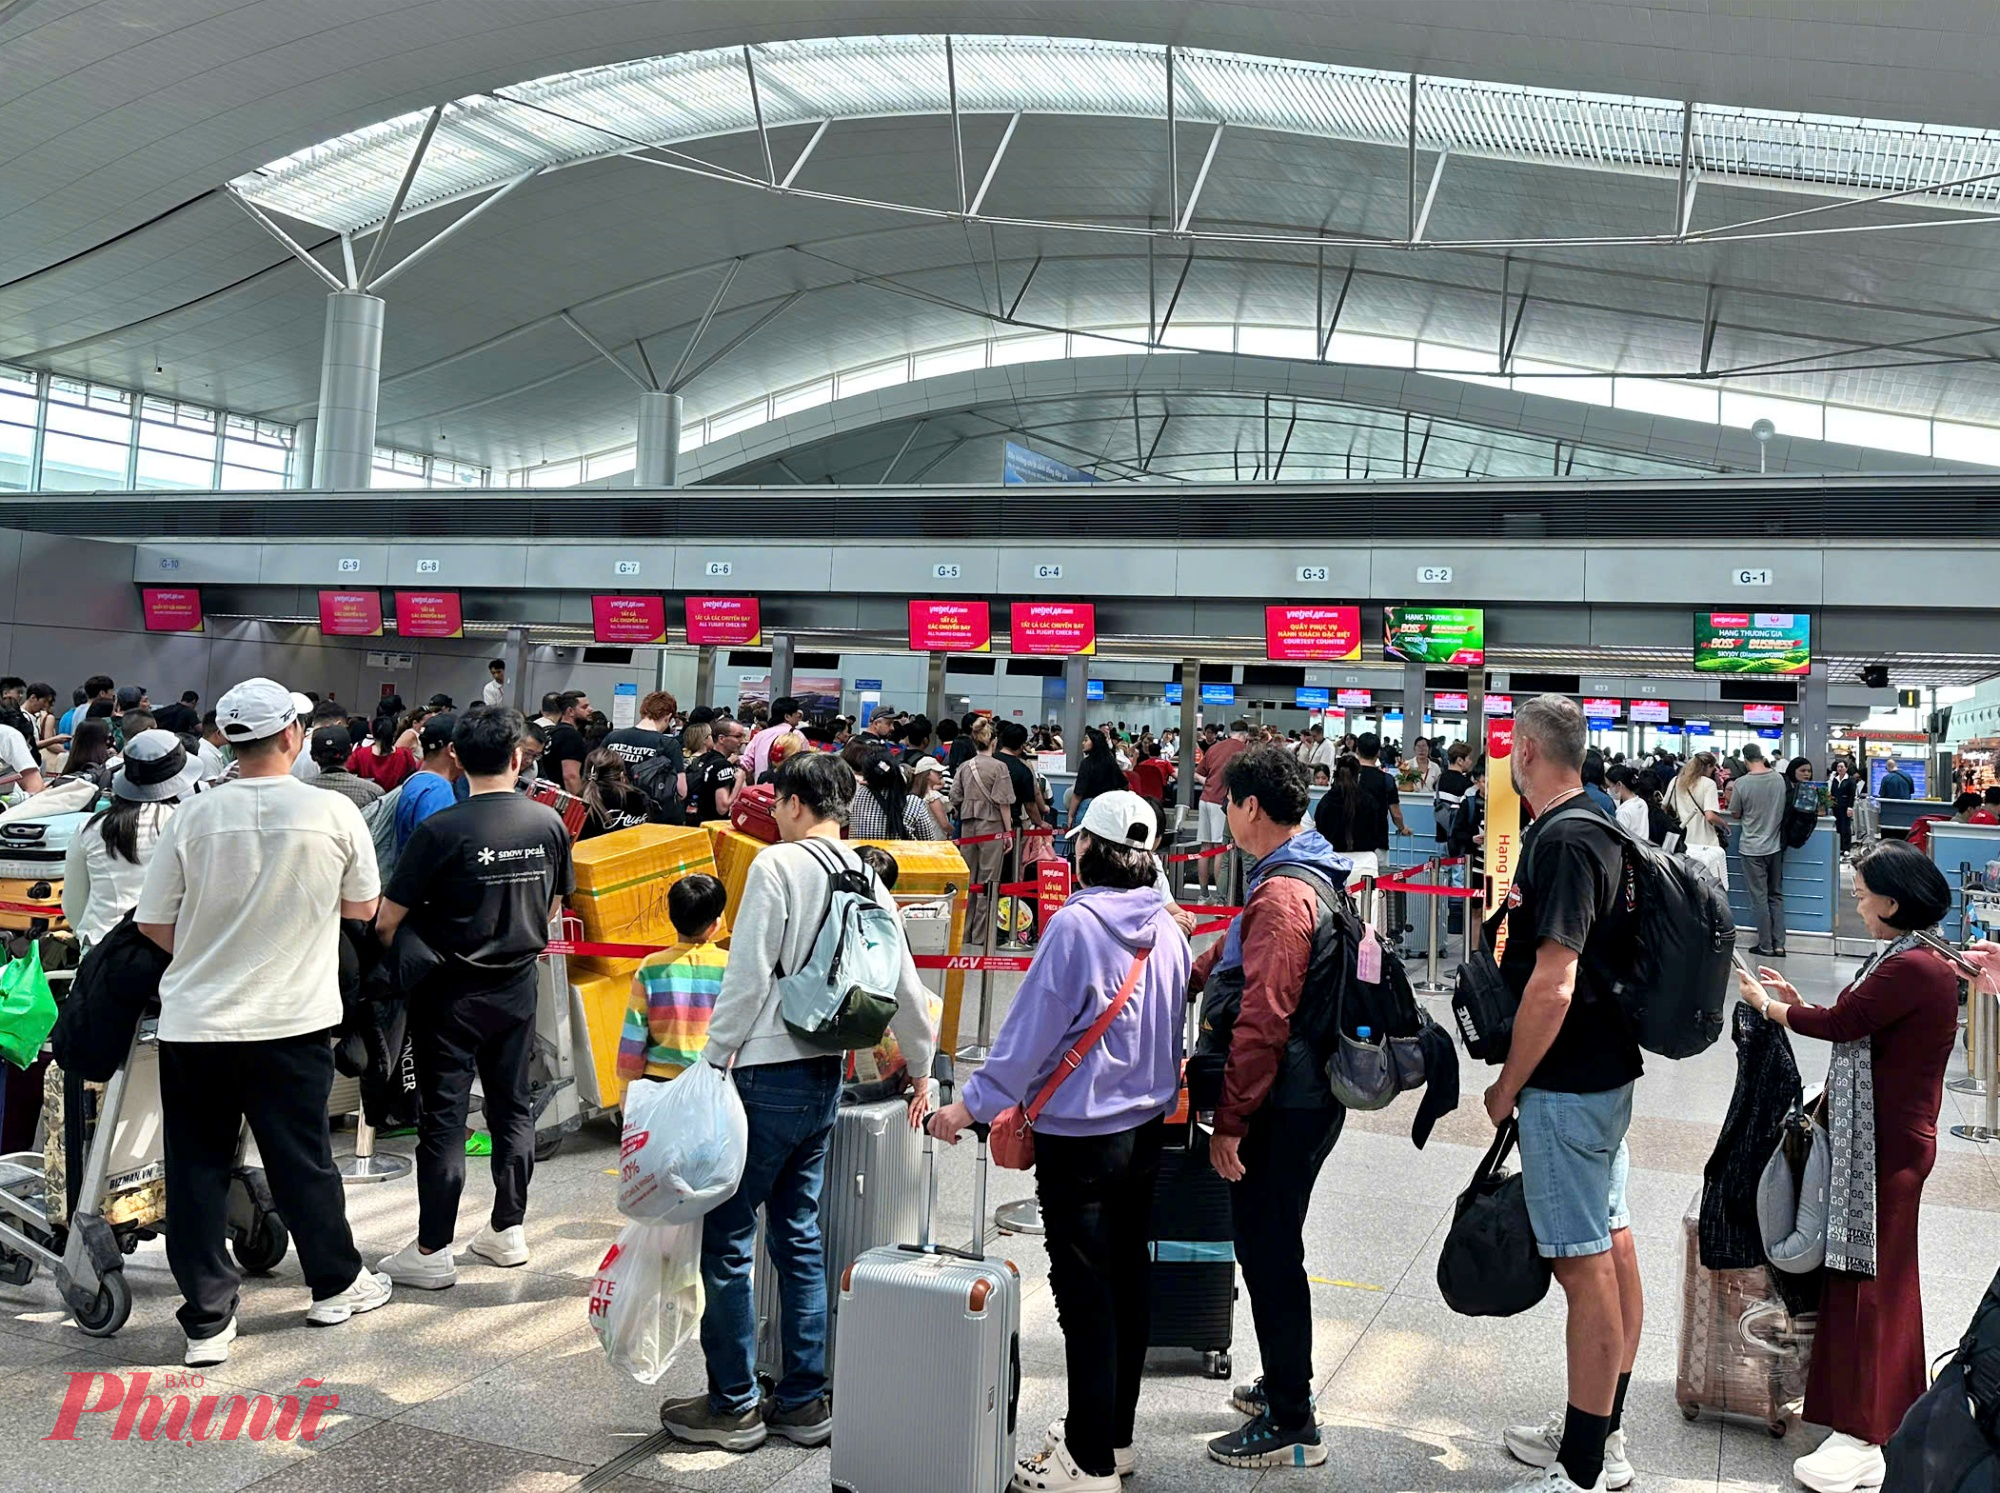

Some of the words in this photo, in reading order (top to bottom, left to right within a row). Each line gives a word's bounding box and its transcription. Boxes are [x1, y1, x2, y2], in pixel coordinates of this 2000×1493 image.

[161, 559, 179, 569] G-10
[342, 560, 358, 570] G-9
[420, 561, 437, 571] G-8
[619, 562, 637, 574] G-7
[711, 563, 729, 574] G-6
[938, 565, 958, 577] G-5
[1039, 566, 1060, 577] G-4
[1302, 568, 1326, 580] G-3
[1424, 568, 1448, 581] G-2
[1740, 571, 1766, 584] G-1
[607, 743, 657, 757] CREATIVE
[498, 848, 523, 859] snow
[524, 844, 545, 859] peak
[1496, 834, 1510, 873] Hạng
[947, 957, 980, 969] ACV
[1456, 1005, 1480, 1042] NIKE
